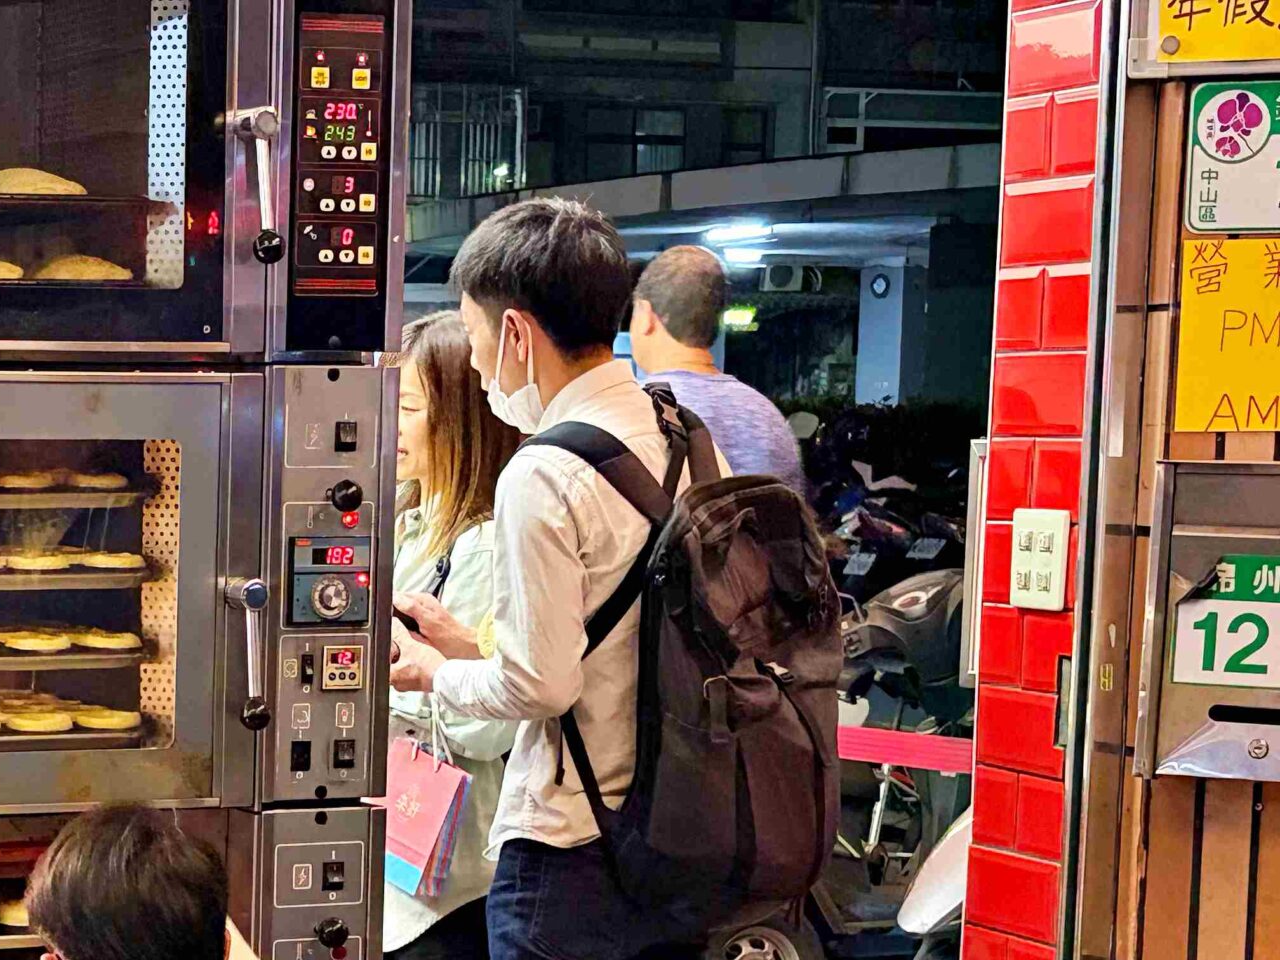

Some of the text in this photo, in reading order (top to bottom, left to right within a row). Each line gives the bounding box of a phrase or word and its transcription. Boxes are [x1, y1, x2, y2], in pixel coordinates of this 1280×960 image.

[324, 125, 356, 141] 243
[344, 176, 355, 193] 3
[1199, 168, 1219, 222] 中山區
[1220, 309, 1280, 353] PM
[1205, 393, 1280, 432] AM
[1192, 611, 1270, 675] 12
